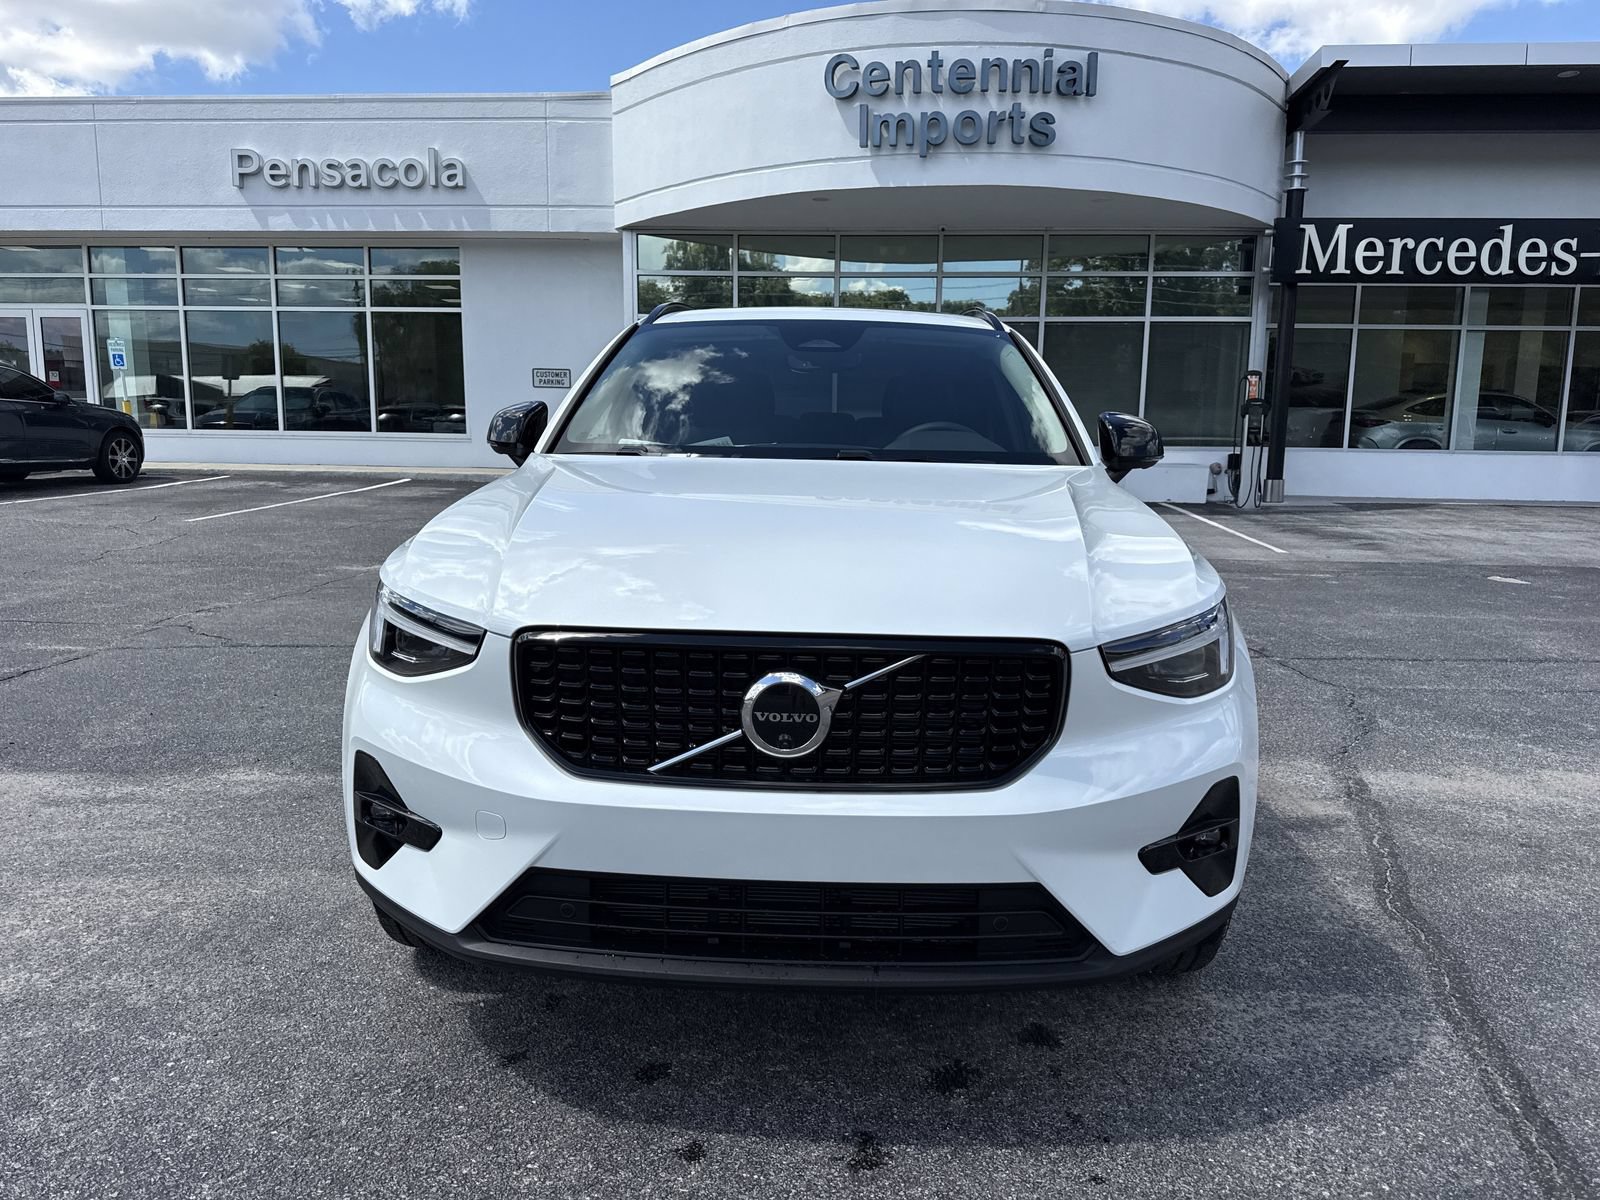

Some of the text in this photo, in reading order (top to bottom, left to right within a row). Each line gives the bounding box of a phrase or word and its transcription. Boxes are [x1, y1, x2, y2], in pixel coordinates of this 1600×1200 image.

[824, 48, 1098, 100] Centennial
[858, 102, 1057, 158] Imports
[231, 147, 466, 189] Pensacola
[754, 712, 818, 723] VOLVO
